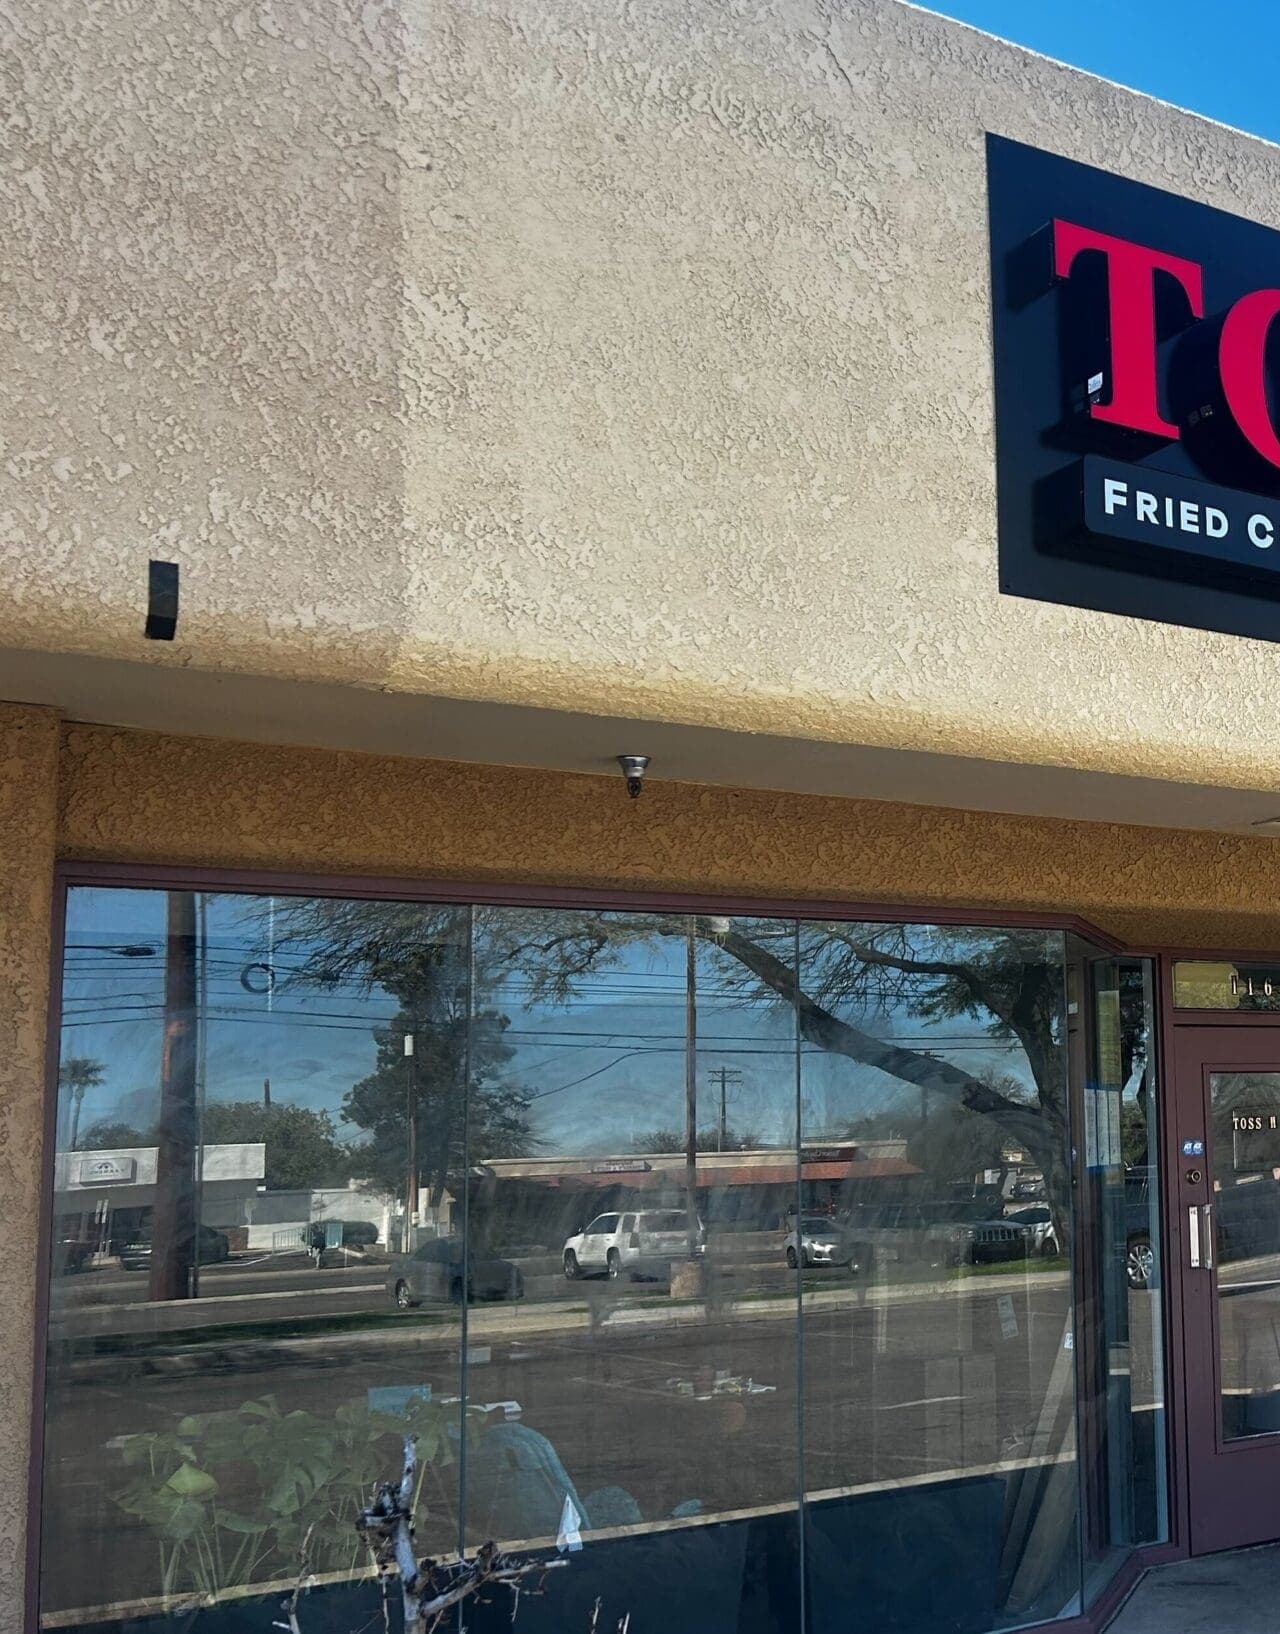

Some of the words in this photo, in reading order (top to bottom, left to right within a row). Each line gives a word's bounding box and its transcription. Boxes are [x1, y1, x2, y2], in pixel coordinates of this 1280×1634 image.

[1104, 478, 1229, 538] FRIED
[1231, 975, 1272, 996] 116
[1233, 1117, 1262, 1129] TOSS
